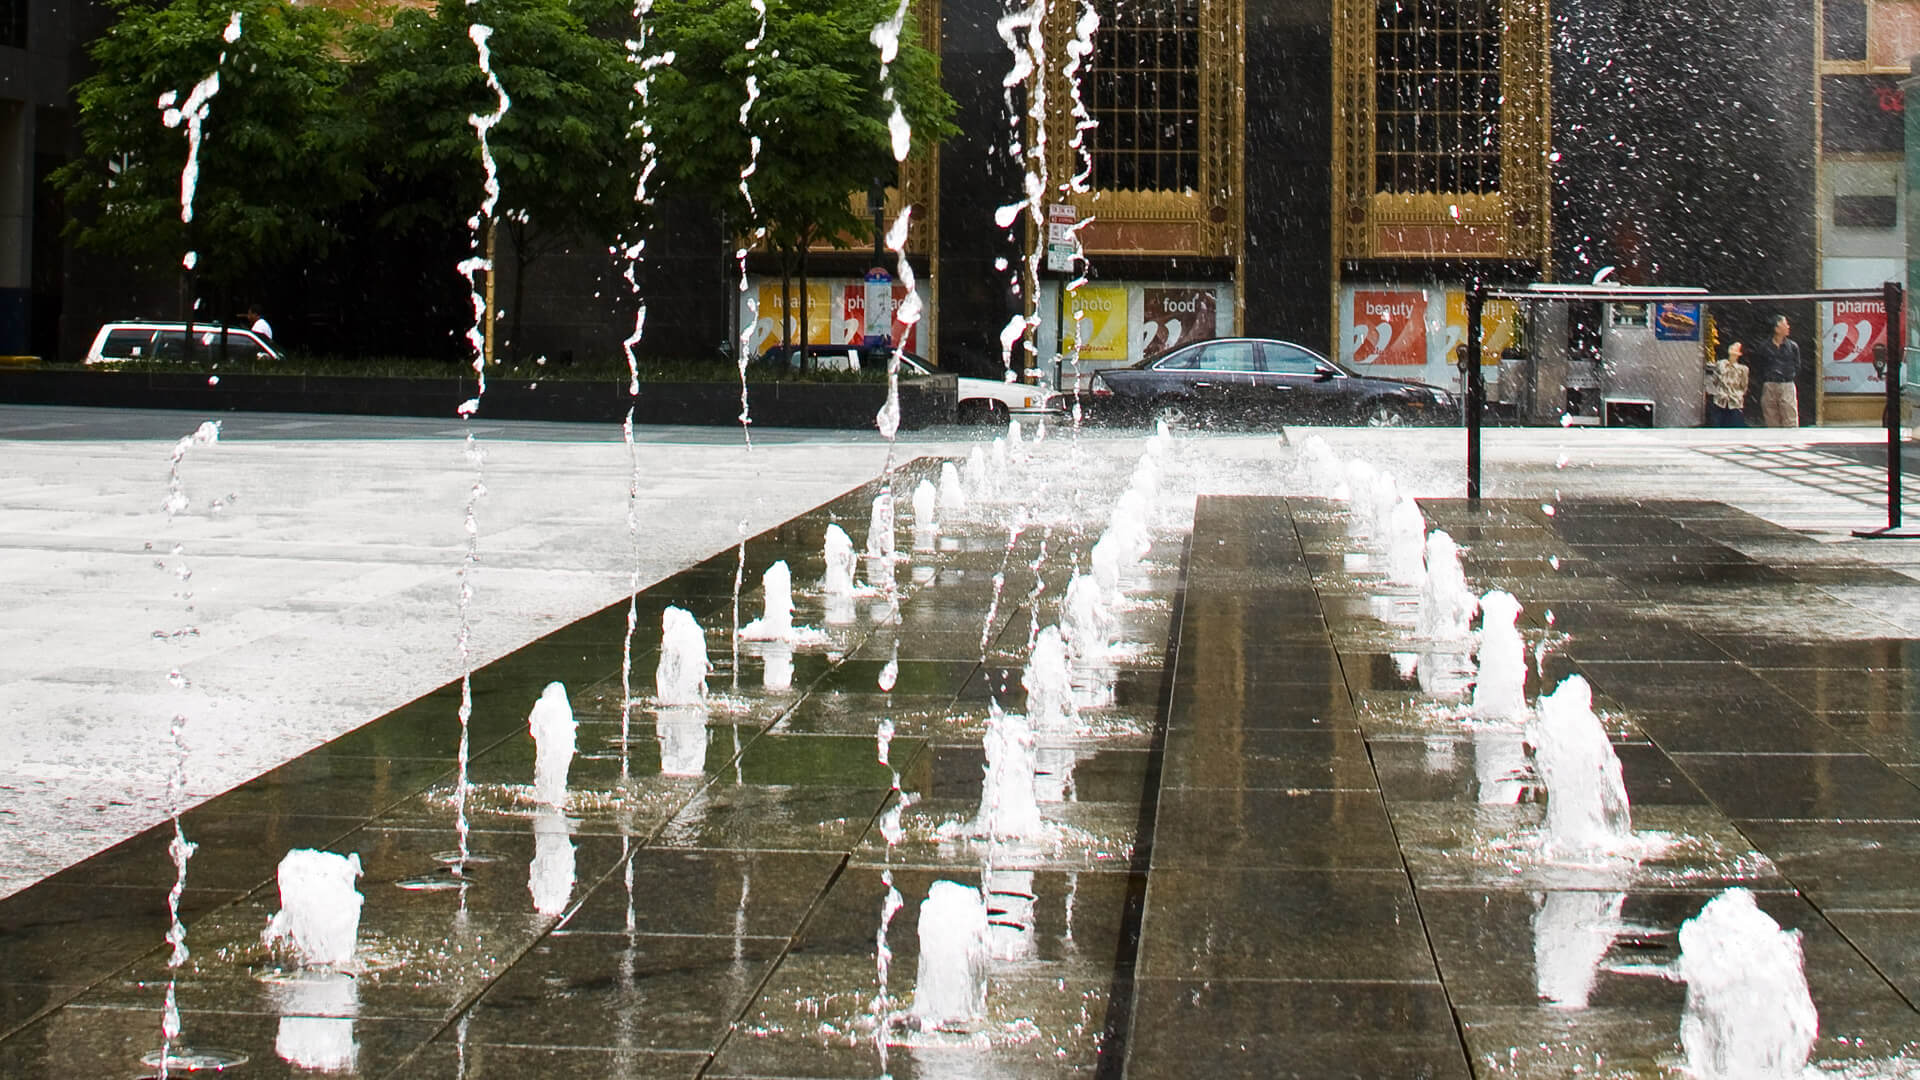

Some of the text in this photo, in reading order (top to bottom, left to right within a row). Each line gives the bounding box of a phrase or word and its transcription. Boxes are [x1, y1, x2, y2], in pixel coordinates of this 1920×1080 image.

[773, 293, 816, 309] halh
[847, 295, 906, 312] phac
[1072, 296, 1112, 313] photo
[1163, 297, 1196, 312] food
[1460, 302, 1504, 316] halth
[1836, 301, 1887, 316] pharma
[1365, 301, 1414, 318] beauty
